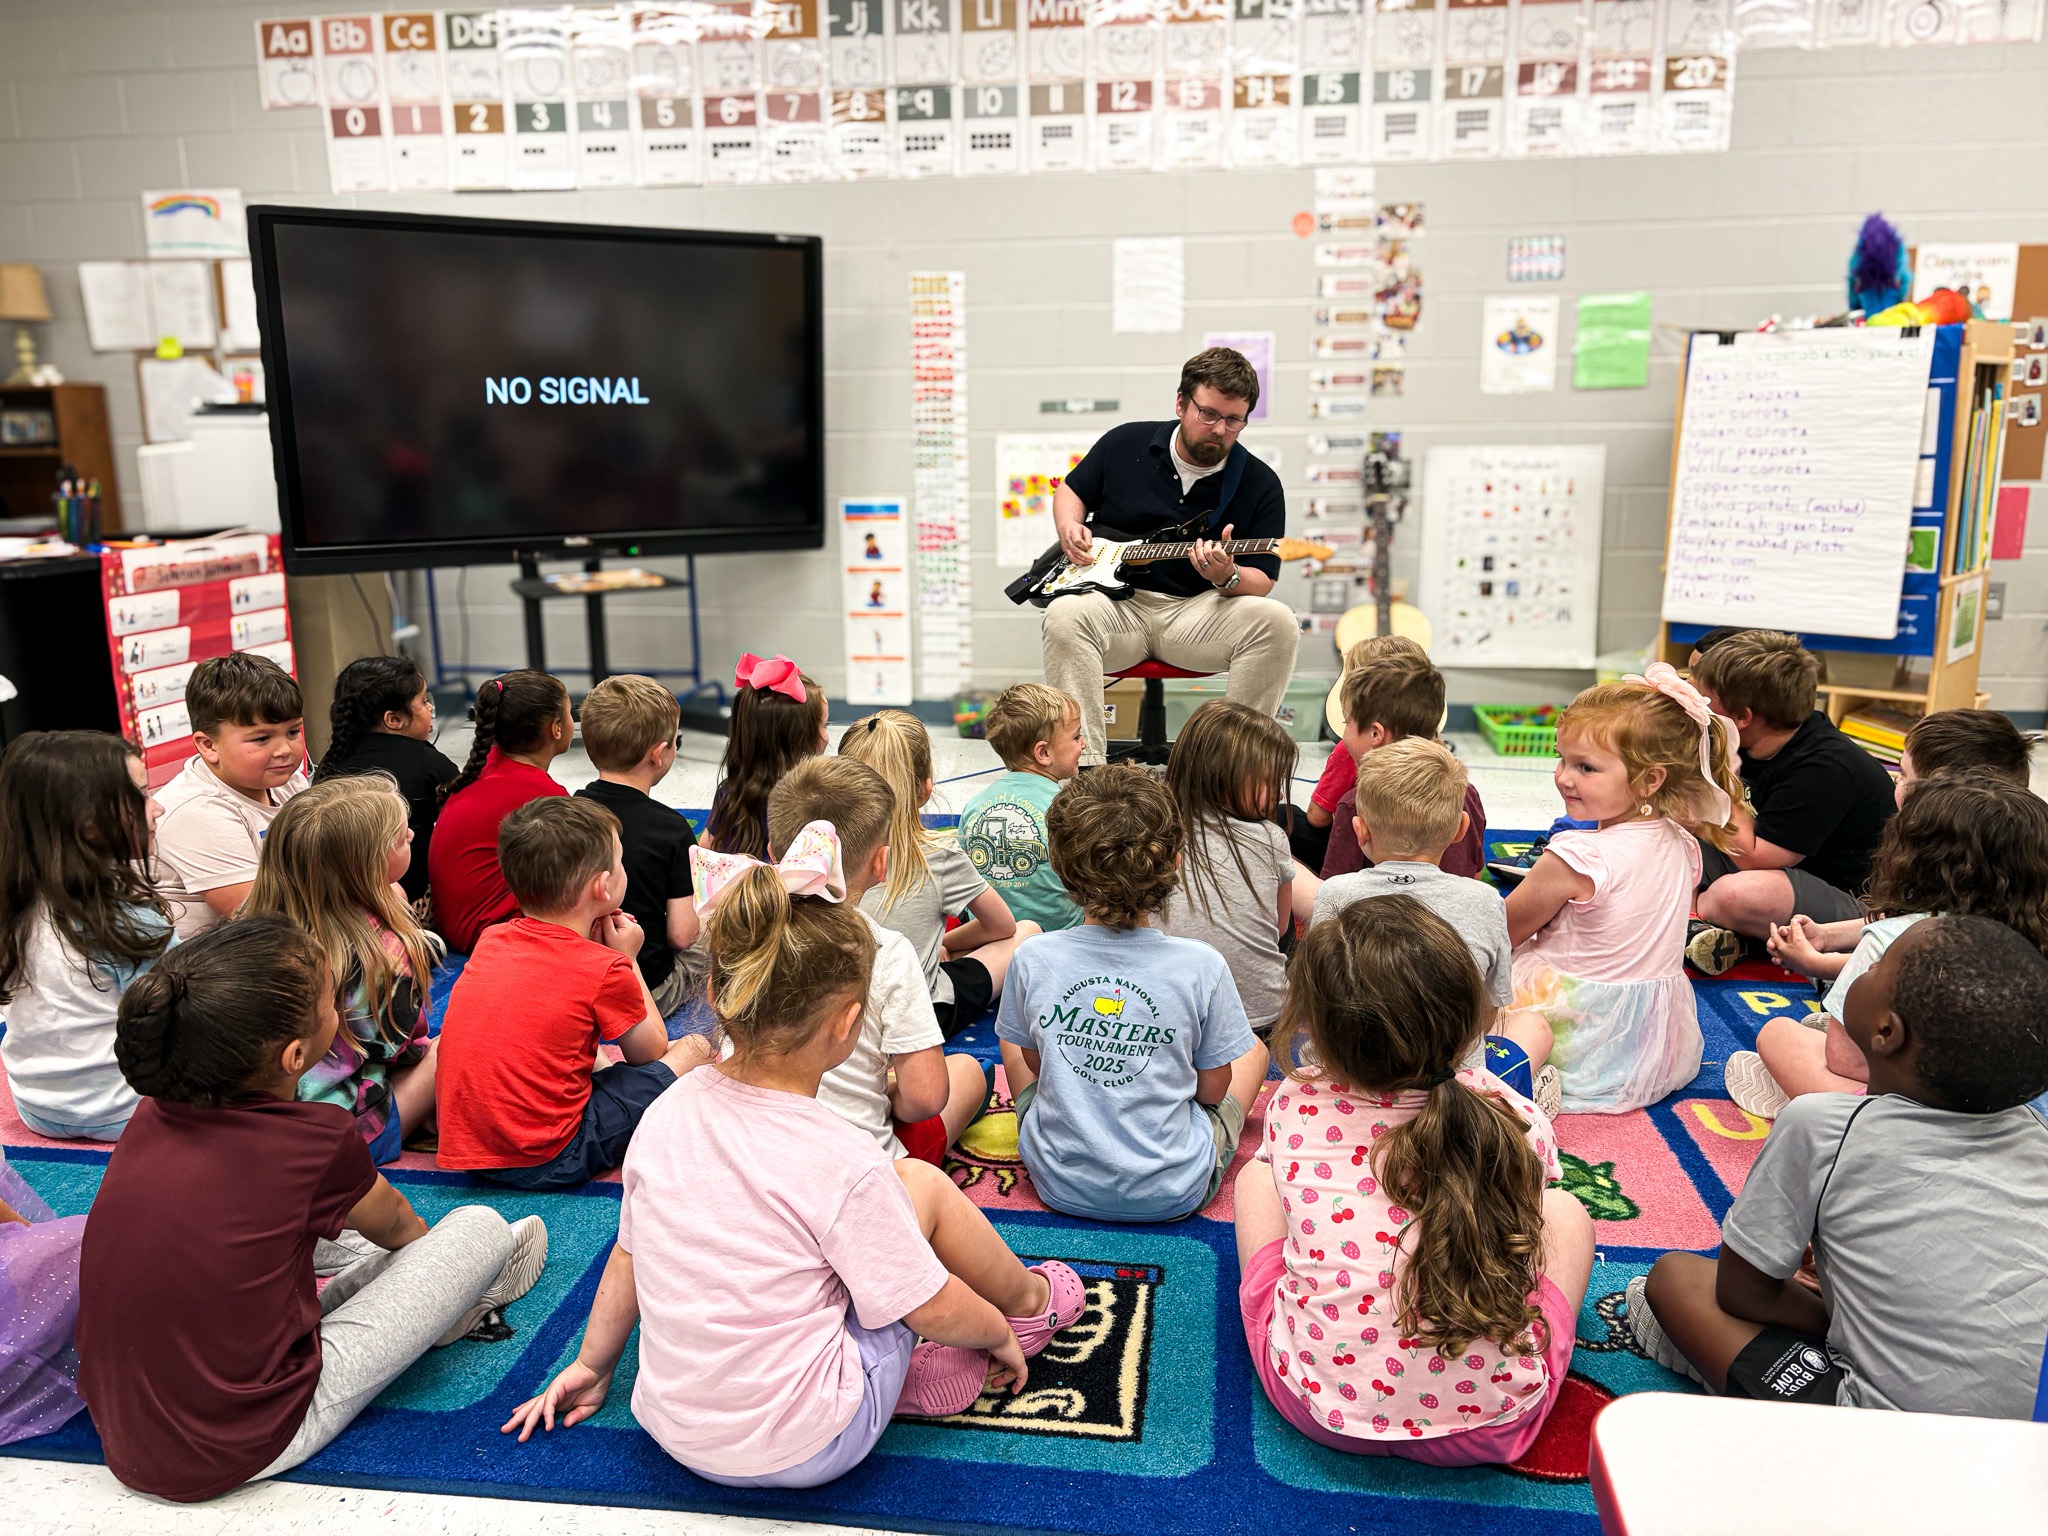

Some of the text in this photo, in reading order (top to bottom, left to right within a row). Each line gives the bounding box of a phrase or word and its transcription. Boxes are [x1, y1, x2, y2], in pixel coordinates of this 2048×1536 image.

[844, 2, 869, 35] Jj
[902, 3, 942, 29] Kk
[268, 26, 307, 54] Aa
[328, 22, 367, 51] Bb
[390, 19, 428, 48] Cc
[1388, 71, 1414, 99] 16
[1461, 68, 1487, 95] 17
[1674, 59, 1716, 87] 20
[977, 88, 1003, 116] 10
[1112, 83, 1137, 109] 12
[1318, 74, 1344, 102] 15
[531, 102, 550, 131] 3
[593, 101, 612, 129] 4
[657, 100, 677, 128] 5
[720, 96, 740, 124] 6
[784, 93, 800, 121] 7
[850, 92, 868, 121] 8
[914, 89, 934, 117] 9
[345, 108, 366, 136] 0
[469, 103, 490, 133] 2
[485, 376, 650, 405] NO SIGNAL
[1062, 976, 1161, 1020] AUGUSTA NATIONAL
[1056, 1033, 1159, 1058] TOURNAMENT
[1072, 1065, 1134, 1088] GOLF CLUB
[1083, 1054, 1127, 1074] 2025
[1770, 1363, 1803, 1395] GLOVE
[1784, 1371, 1815, 1397] BODY
